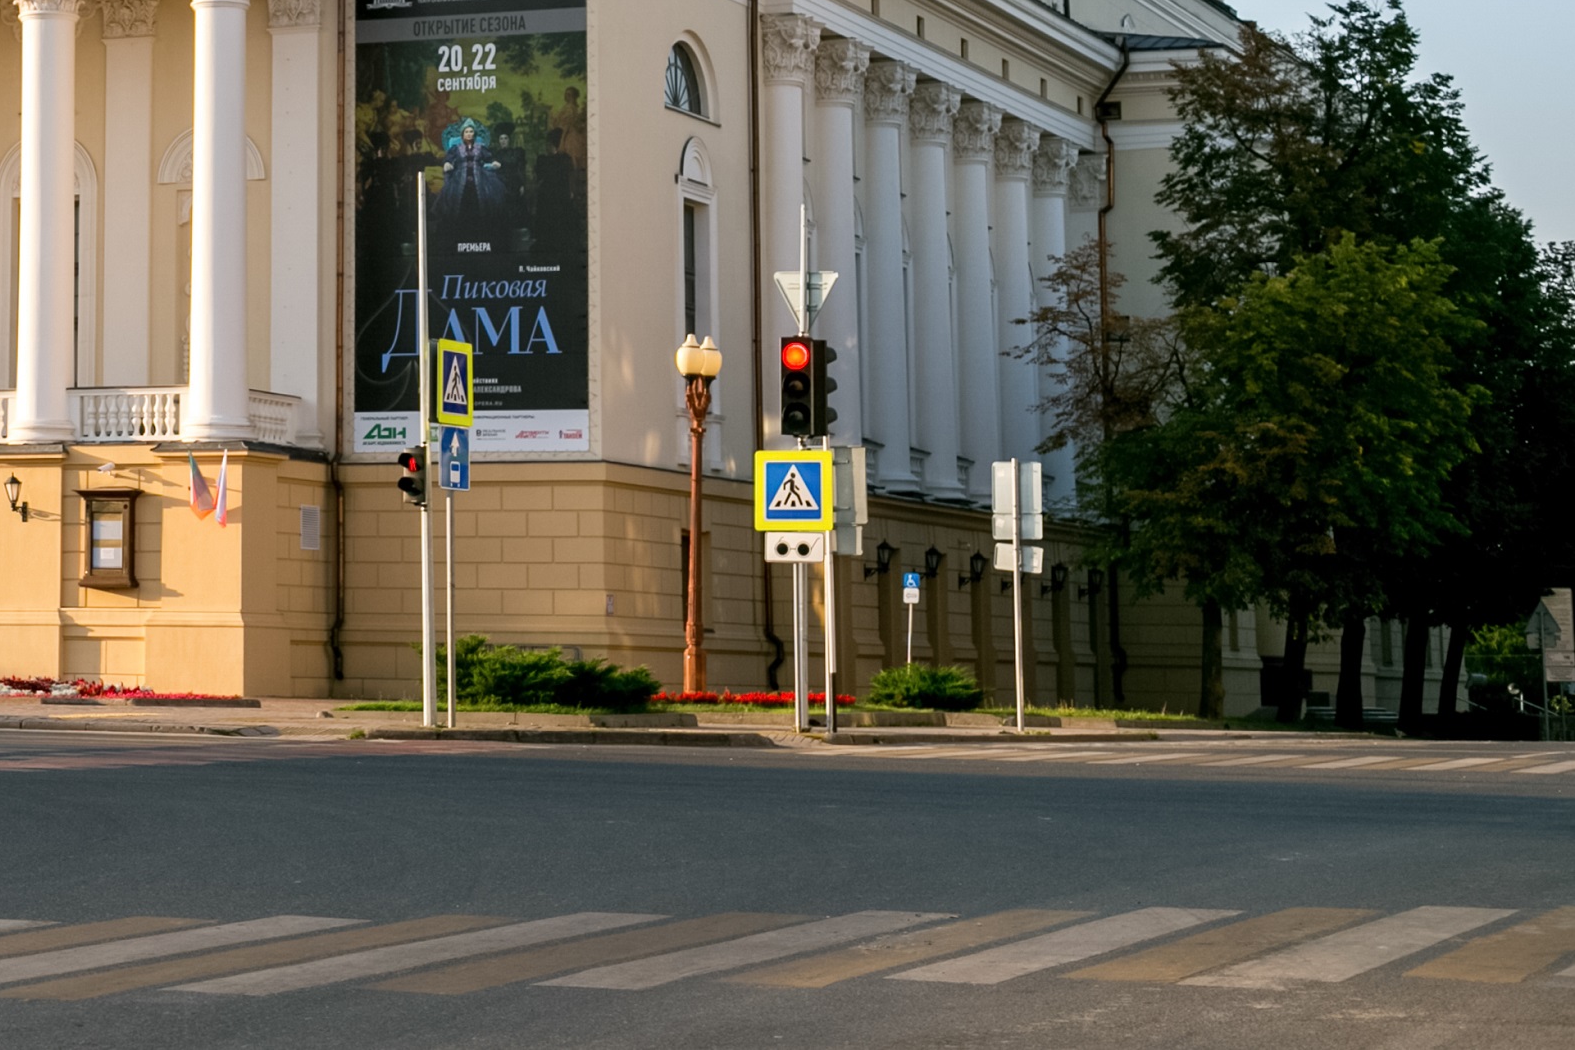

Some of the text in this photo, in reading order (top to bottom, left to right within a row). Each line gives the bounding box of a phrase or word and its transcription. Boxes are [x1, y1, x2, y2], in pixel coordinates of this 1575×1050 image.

[413, 15, 526, 37] ОТКРЫТИЕ СЕЗОНА
[438, 42, 497, 74] 20, 22
[437, 72, 497, 93] сентября
[457, 242, 491, 252] ПРЕМЬЕРА
[526, 264, 561, 272] Чайковский
[440, 274, 547, 300] Пиковая
